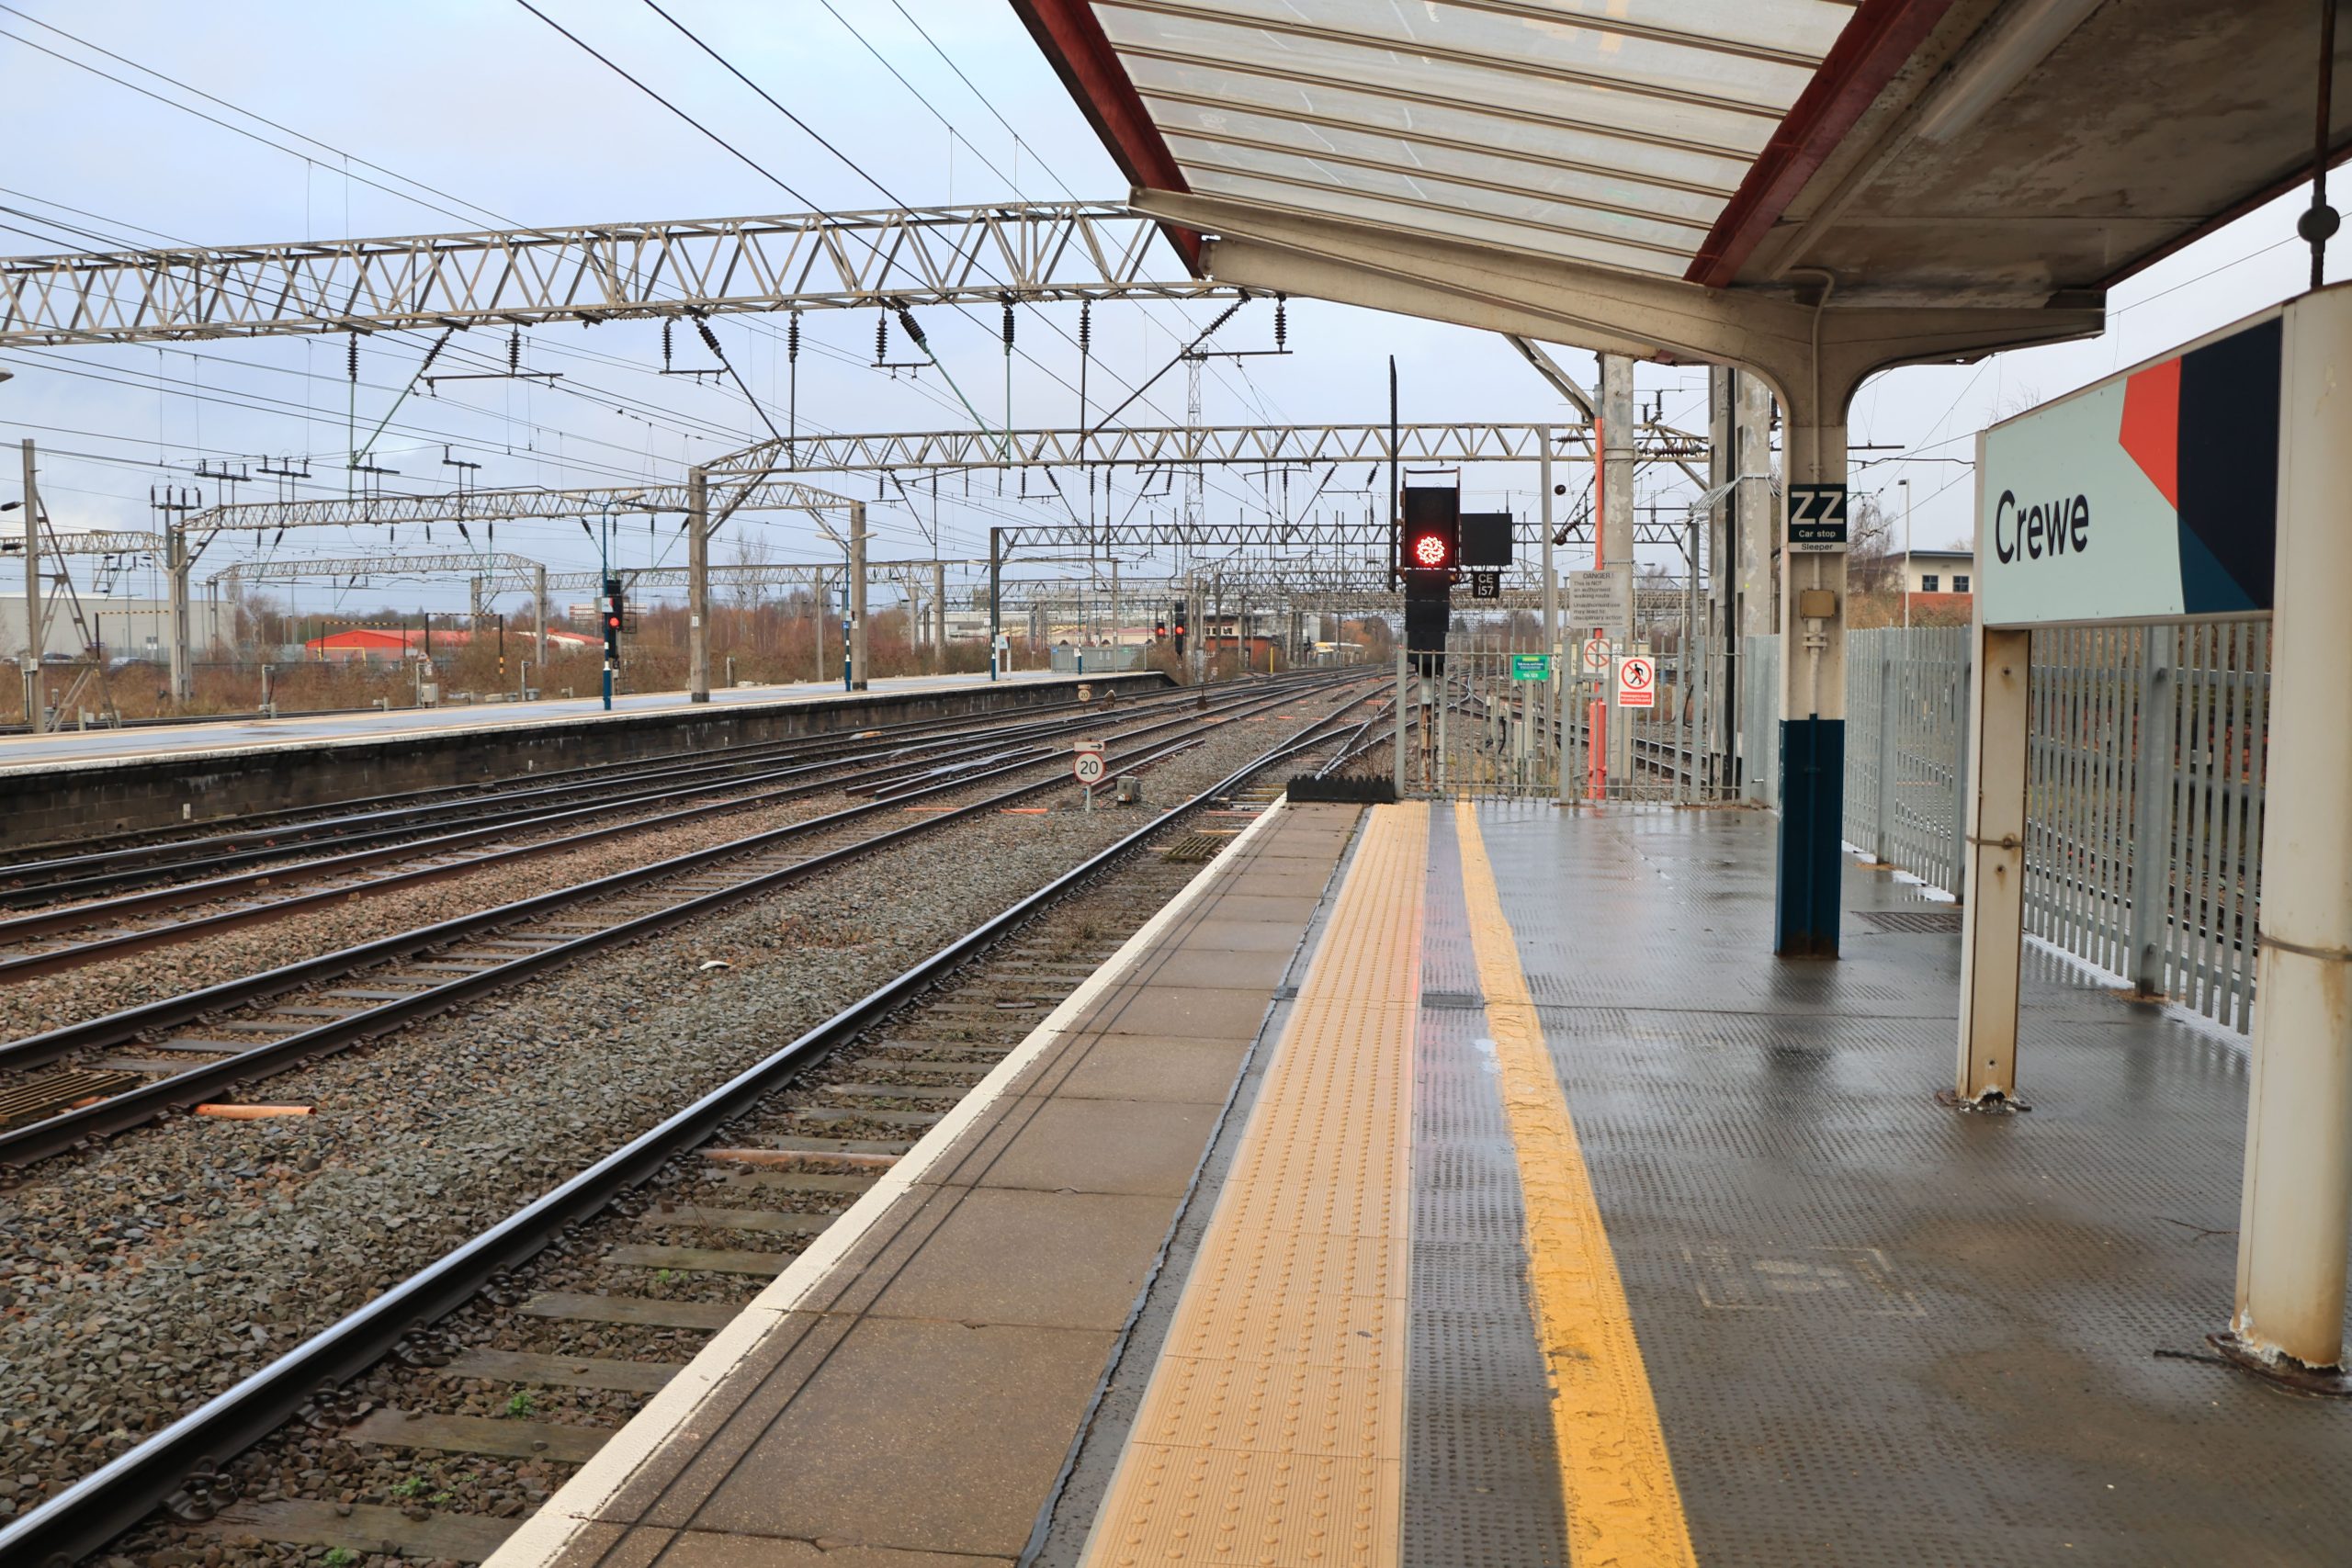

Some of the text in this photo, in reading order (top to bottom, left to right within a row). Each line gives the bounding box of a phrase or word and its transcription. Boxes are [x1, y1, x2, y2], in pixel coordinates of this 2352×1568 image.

[1791, 491, 1844, 525] ZZ
[1996, 490, 2089, 564] Crewe
[1816, 530, 1836, 538] stop
[1801, 543, 1833, 551] Sleeper
[1478, 573, 1494, 583] CE
[1478, 585, 1494, 596] 157
[1080, 761, 1099, 774] 20
